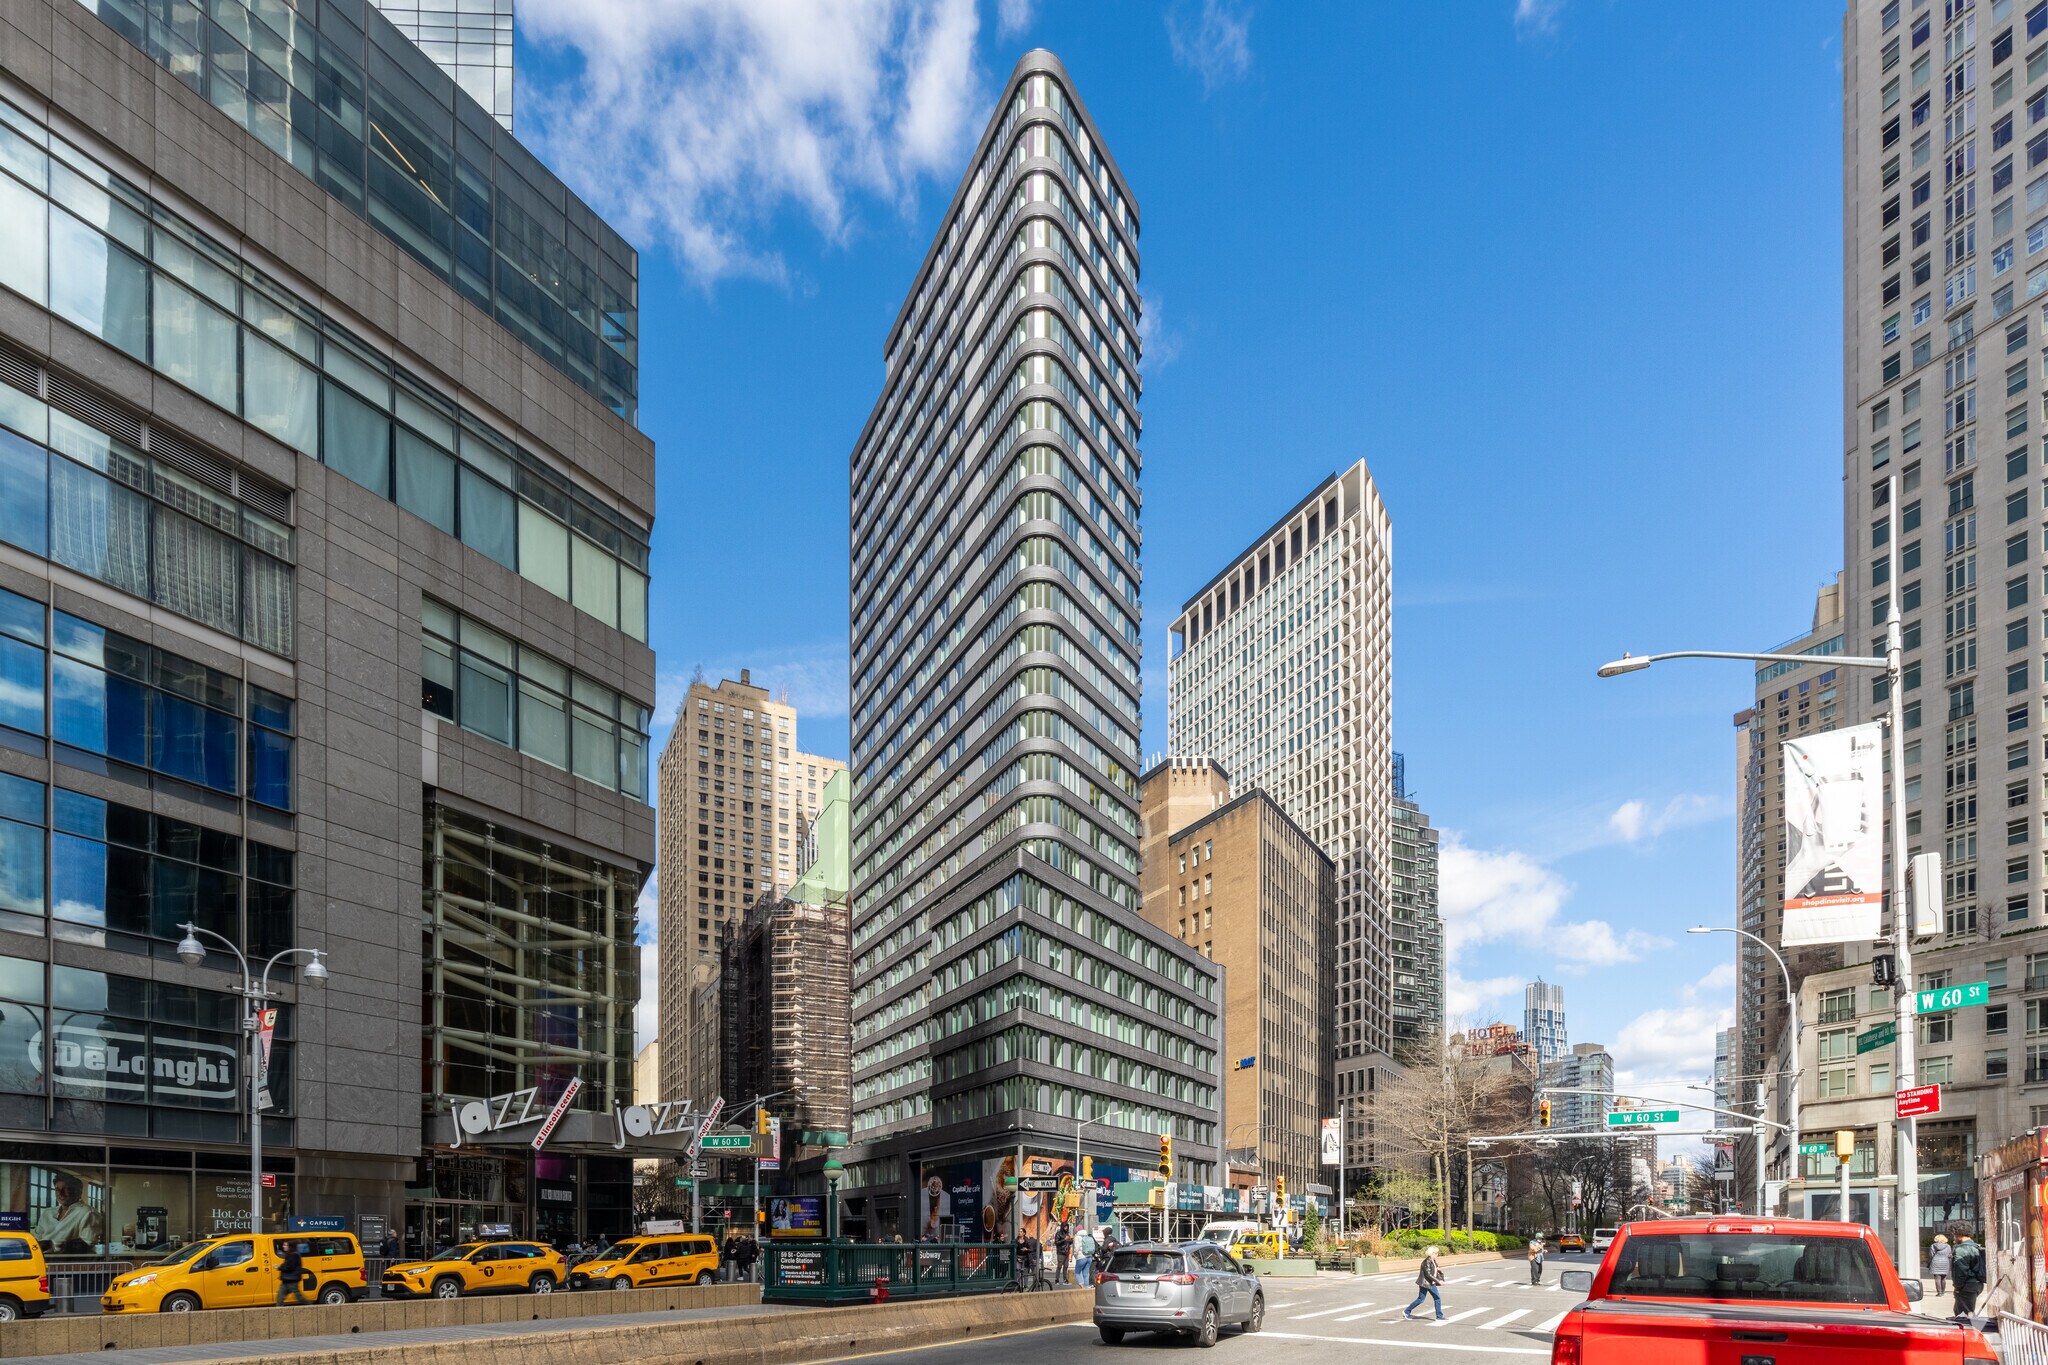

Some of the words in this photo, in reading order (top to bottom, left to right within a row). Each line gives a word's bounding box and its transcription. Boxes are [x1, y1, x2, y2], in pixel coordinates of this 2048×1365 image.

[1801, 896, 1866, 907] shopdinevisit.org
[1921, 993, 1935, 1009] W
[1941, 989, 1962, 1007] 60
[1969, 986, 1980, 997] St
[1468, 1026, 1507, 1040] HOTEL
[1907, 1088, 1934, 1098] STANDING
[536, 1136, 545, 1146] at
[541, 1109, 562, 1137] lincoln
[560, 1082, 579, 1109] center
[709, 1100, 723, 1121] center
[450, 1086, 544, 1149] jazz
[1623, 1114, 1632, 1122] W
[1636, 1113, 1650, 1122] 60
[1654, 1112, 1664, 1122] St
[614, 1099, 694, 1149] jazz
[712, 1138, 719, 1146] W
[721, 1138, 731, 1146] 60
[733, 1138, 741, 1146] St
[1808, 1145, 1818, 1153] 60
[212, 1208, 235, 1218] Hot.
[216, 1219, 252, 1229] Perfett
[919, 1251, 941, 1260] Subway
